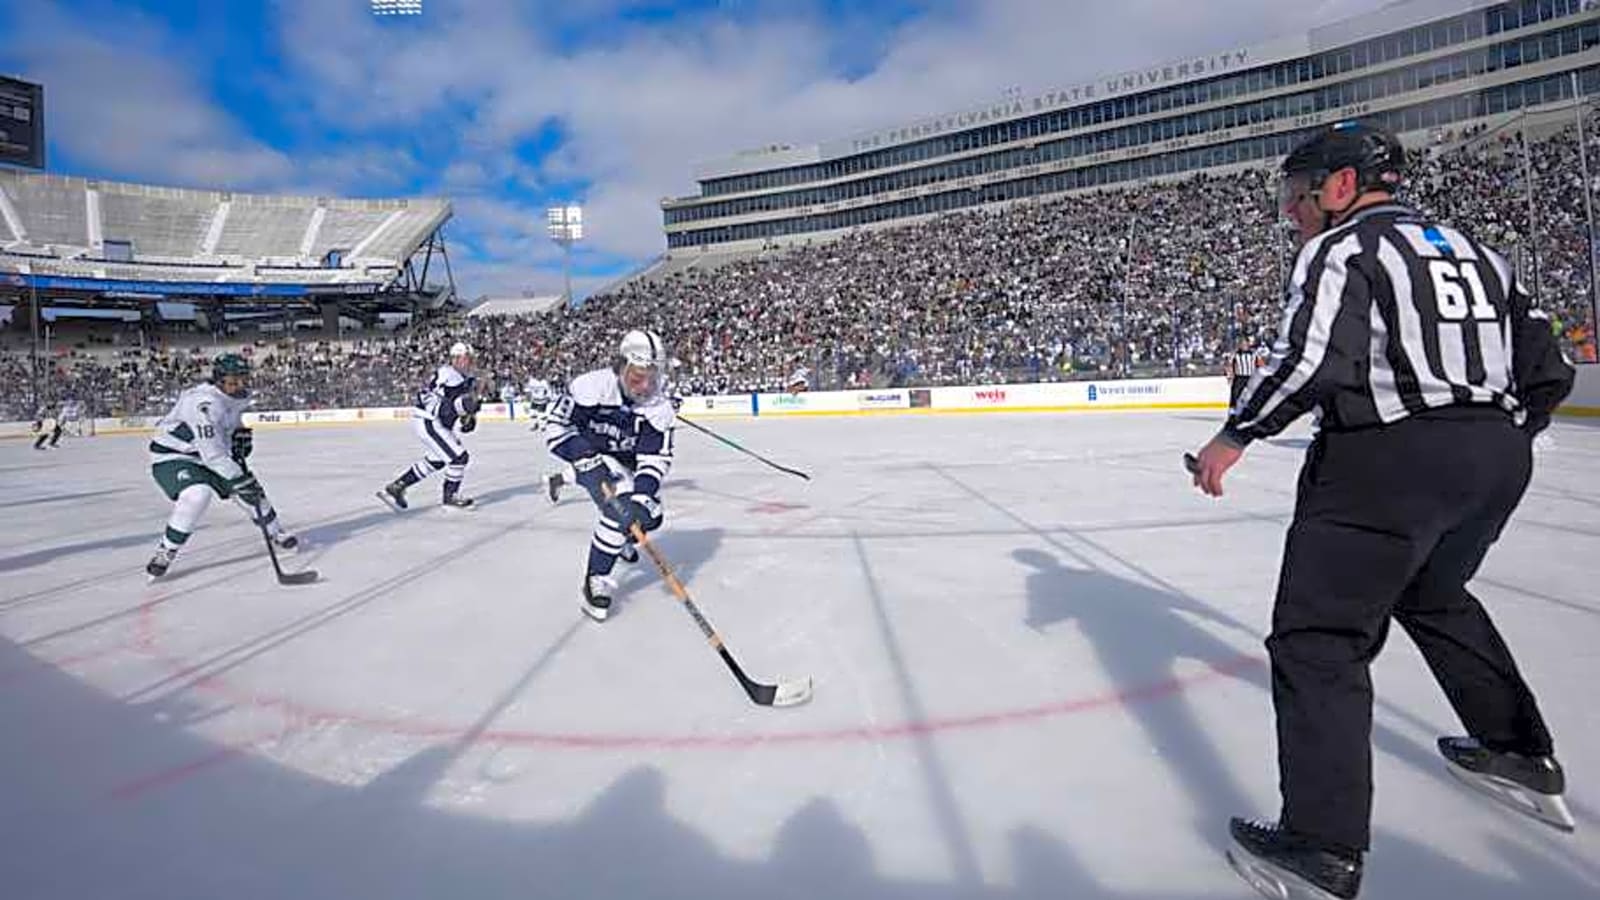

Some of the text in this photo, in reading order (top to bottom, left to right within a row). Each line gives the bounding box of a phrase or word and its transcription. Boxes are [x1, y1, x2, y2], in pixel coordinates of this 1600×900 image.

[852, 49, 1248, 151] THE PENNSYLVANIA STATE UNIVERSITY
[1294, 115, 1322, 127] 2012
[1429, 260, 1497, 319] 61
[197, 425, 215, 440] 18
